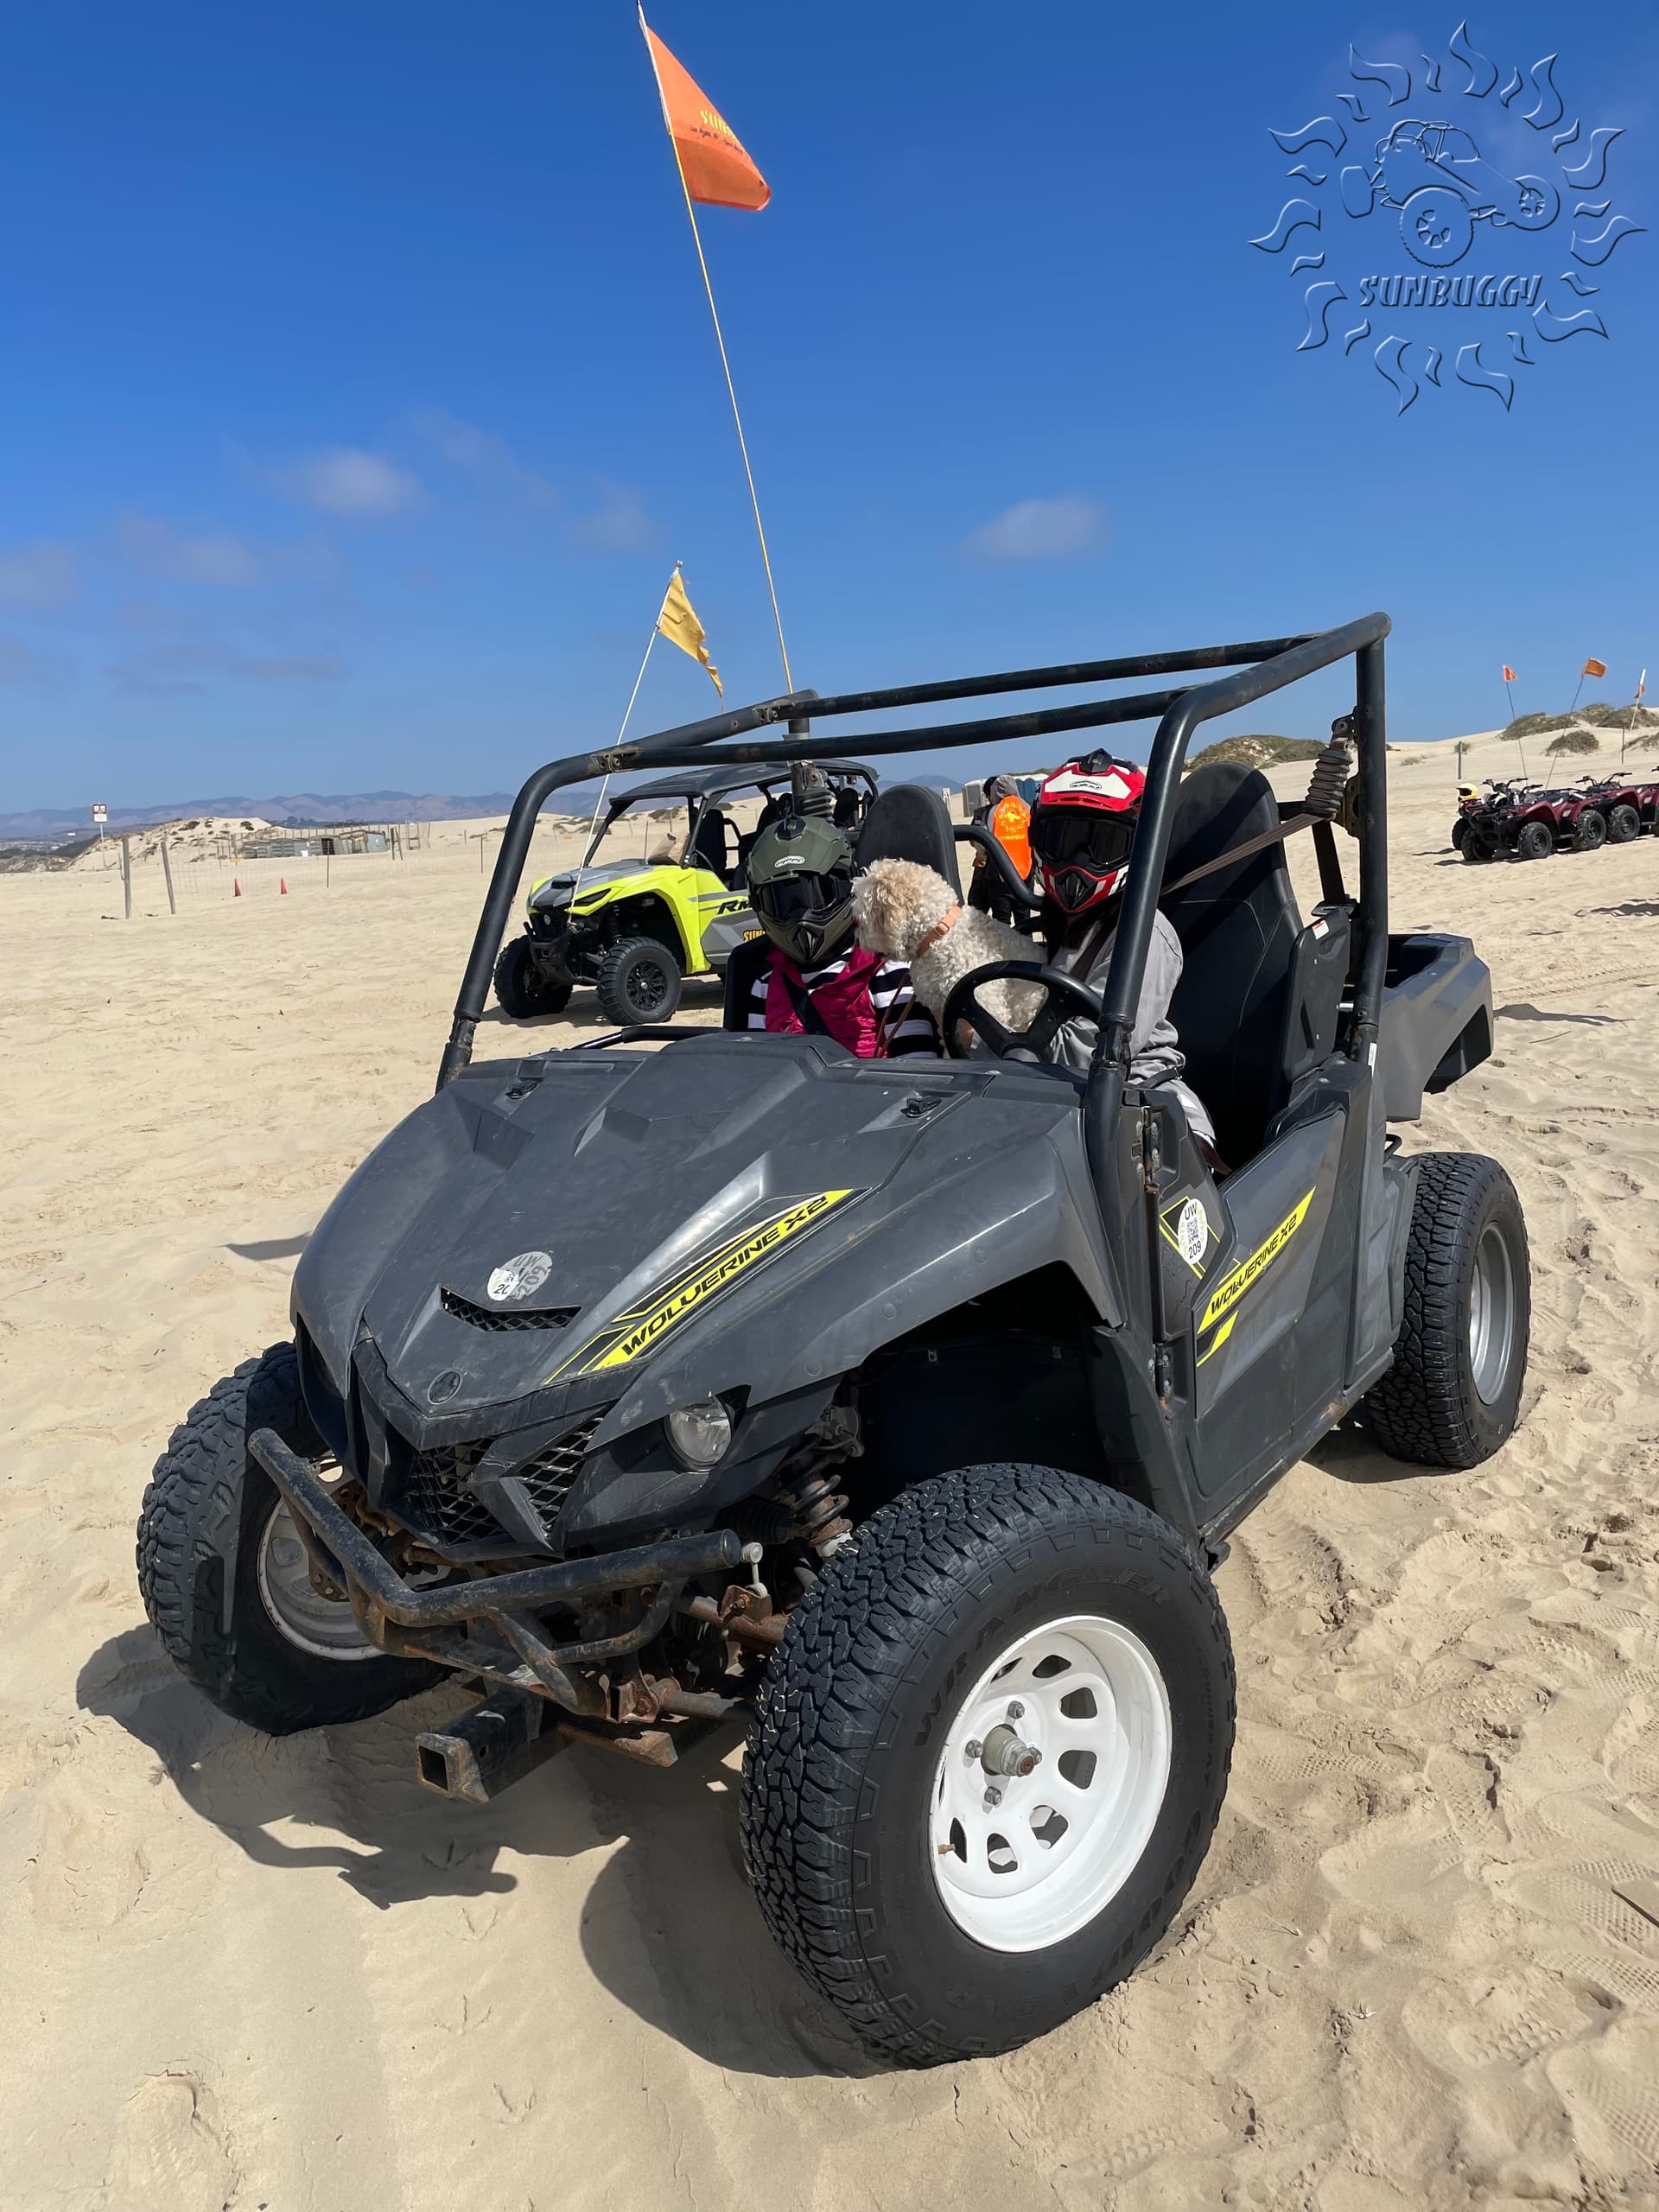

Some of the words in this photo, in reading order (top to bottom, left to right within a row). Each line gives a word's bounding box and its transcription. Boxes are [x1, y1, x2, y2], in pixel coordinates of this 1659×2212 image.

[743, 928, 766, 942] SUN
[1184, 1202, 1198, 1221] UW
[1188, 1240, 1202, 1260] 209
[1211, 1235, 1279, 1314] WOLVERINE
[1279, 1213, 1298, 1243] X2
[622, 1226, 781, 1356] WOLVERINE
[785, 1195, 829, 1230] X2
